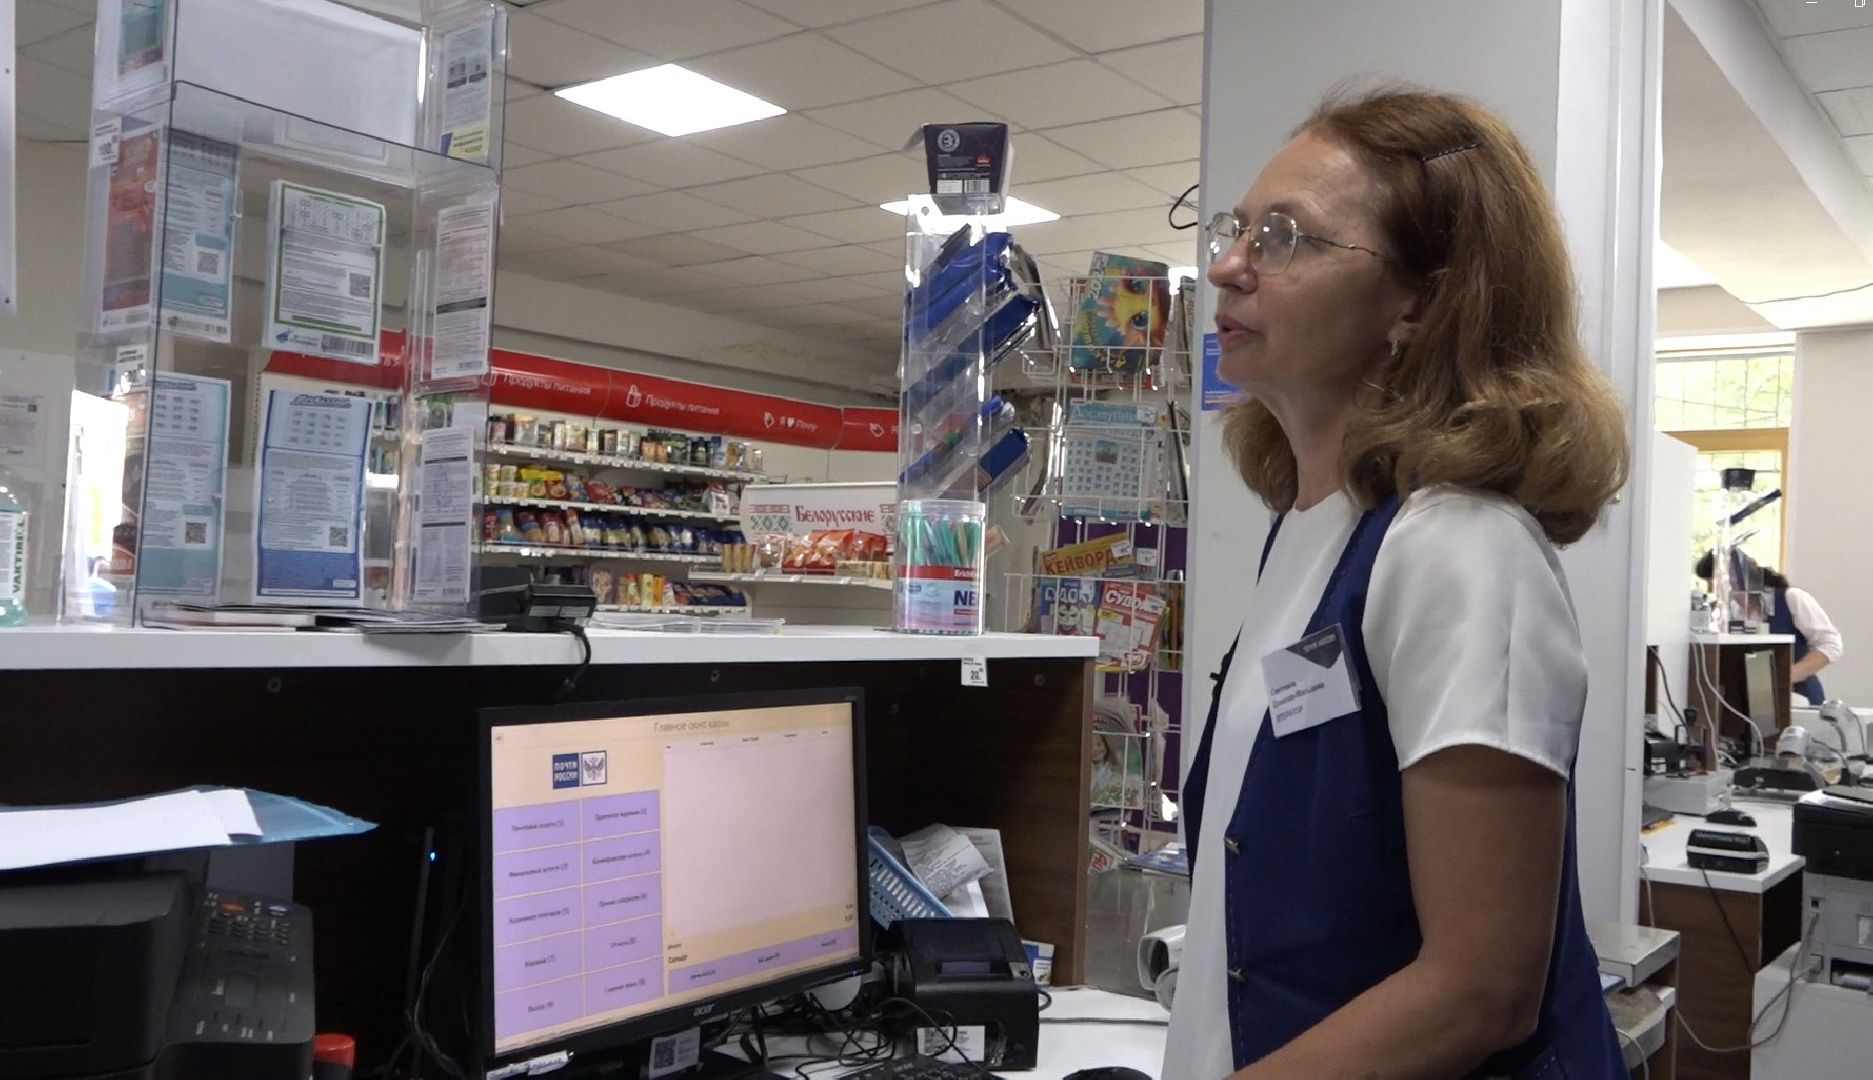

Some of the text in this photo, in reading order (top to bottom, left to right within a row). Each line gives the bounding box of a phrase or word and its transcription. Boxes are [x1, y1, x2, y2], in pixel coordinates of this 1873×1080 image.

[503, 373, 591, 395] Продукты питания
[646, 394, 720, 415] Продукты питания
[795, 505, 875, 527] Белорусские
[554, 760, 577, 772] ПОЧТА
[554, 771, 578, 782] РОССИИ
[692, 1003, 715, 1017] acer
